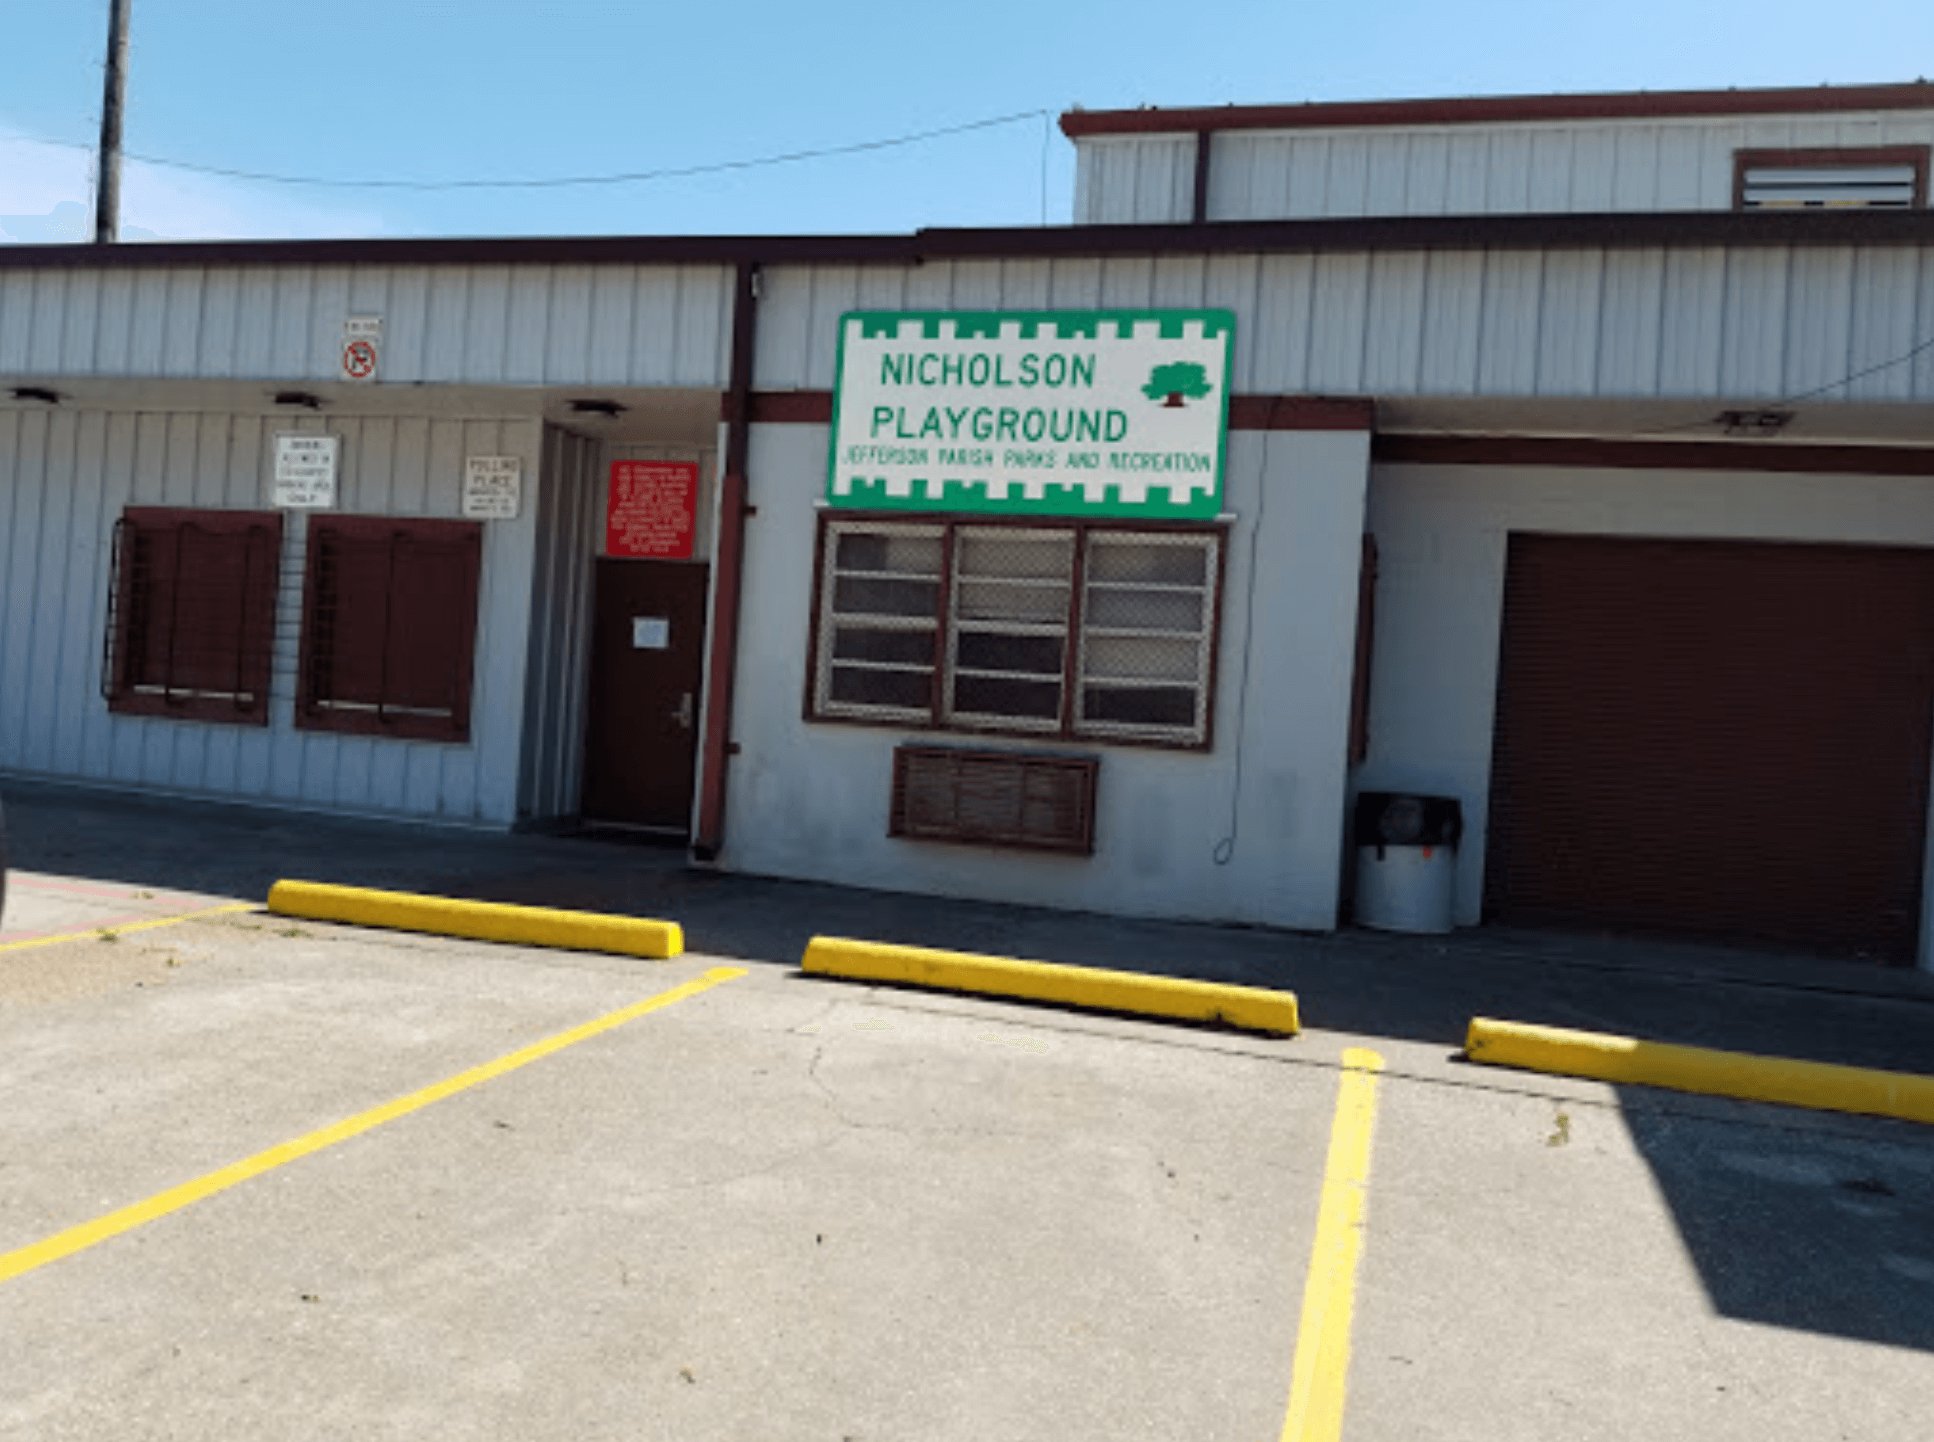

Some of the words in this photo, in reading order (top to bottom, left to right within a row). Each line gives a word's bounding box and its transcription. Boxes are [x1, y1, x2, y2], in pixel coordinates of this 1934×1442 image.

[880, 352, 1096, 388] NICHOLSON
[869, 406, 1128, 442] PLAYGROUND
[842, 445, 929, 466] JEFFERSON
[938, 448, 994, 467] PARISH
[1003, 449, 1056, 469] PARKS
[1064, 452, 1100, 470] AND
[1109, 452, 1212, 473] RECREATION
